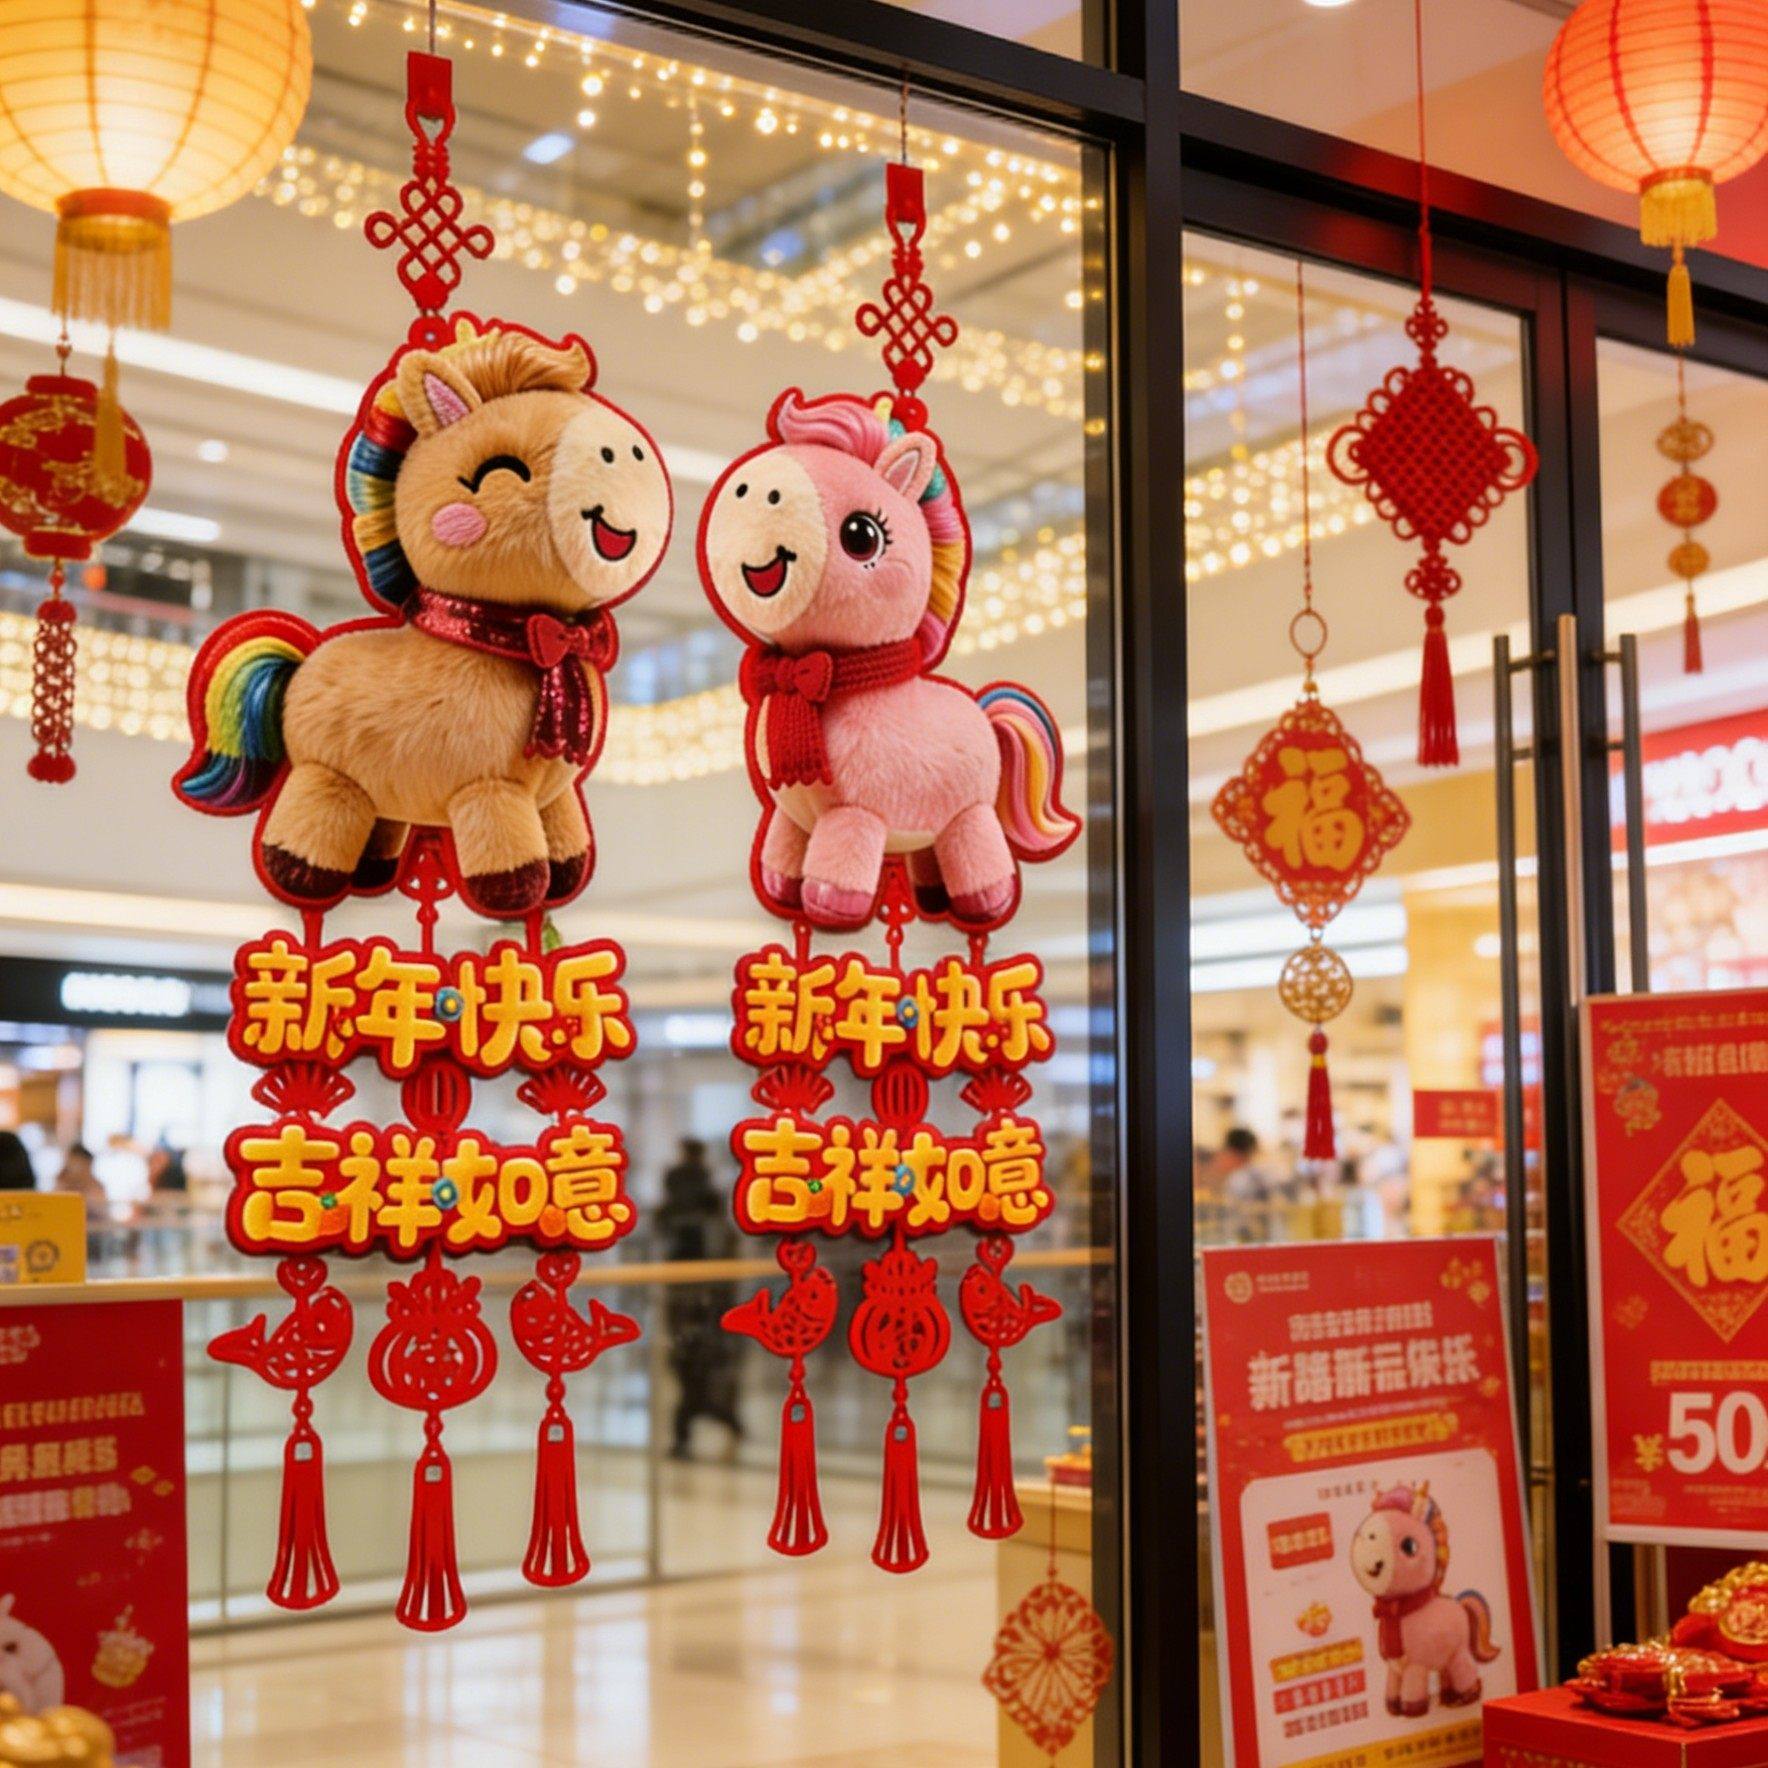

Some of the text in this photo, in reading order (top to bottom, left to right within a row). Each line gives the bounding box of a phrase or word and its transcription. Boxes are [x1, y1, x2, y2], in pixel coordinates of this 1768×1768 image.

[1262, 746, 1366, 870] 福
[243, 939, 631, 1069] 新年快乐
[745, 952, 1050, 1069] 新年快乐
[239, 1125, 630, 1248] 吉祥如意
[743, 1118, 1050, 1228] 吉祥如意
[1660, 1145, 1768, 1288] 福
